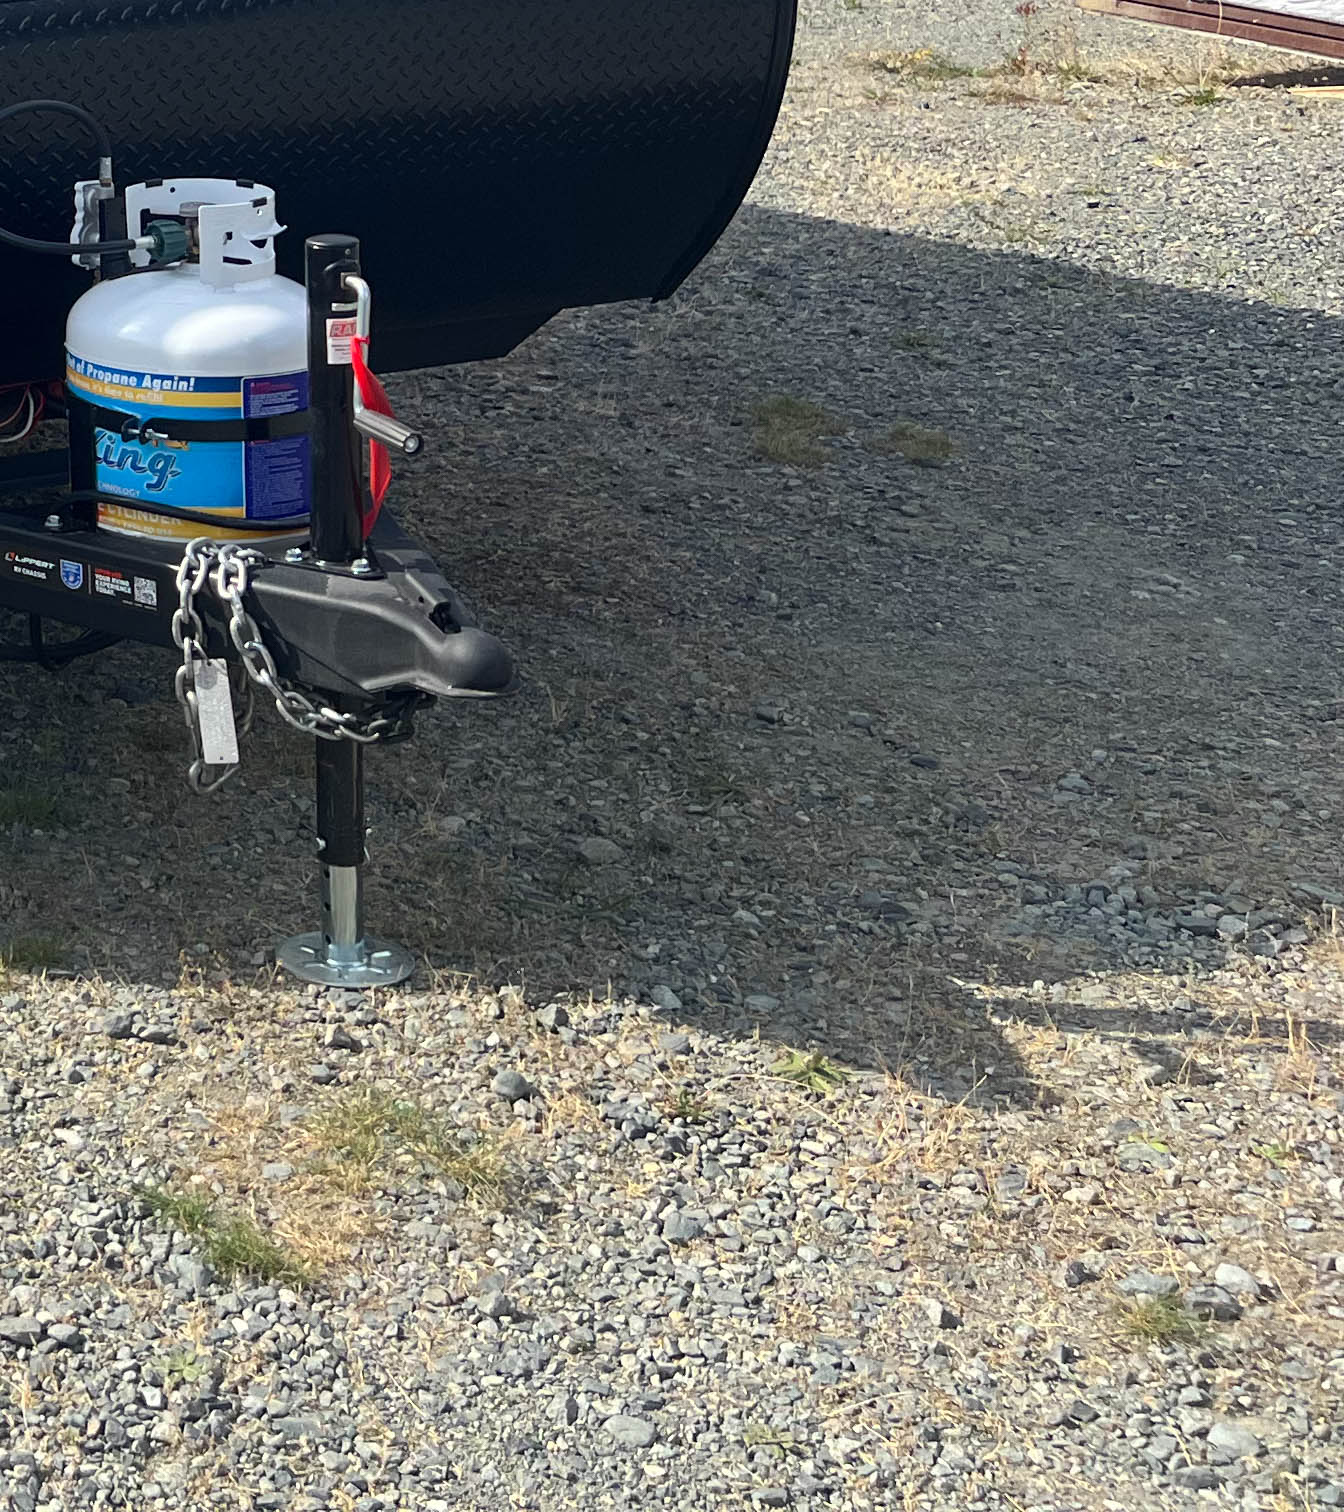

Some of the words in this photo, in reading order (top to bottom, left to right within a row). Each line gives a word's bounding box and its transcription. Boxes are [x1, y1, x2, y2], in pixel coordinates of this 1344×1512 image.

[86, 364, 138, 387] Propane
[141, 374, 195, 392] Again!
[95, 428, 183, 493] ing
[14, 554, 56, 570] LIPPERT
